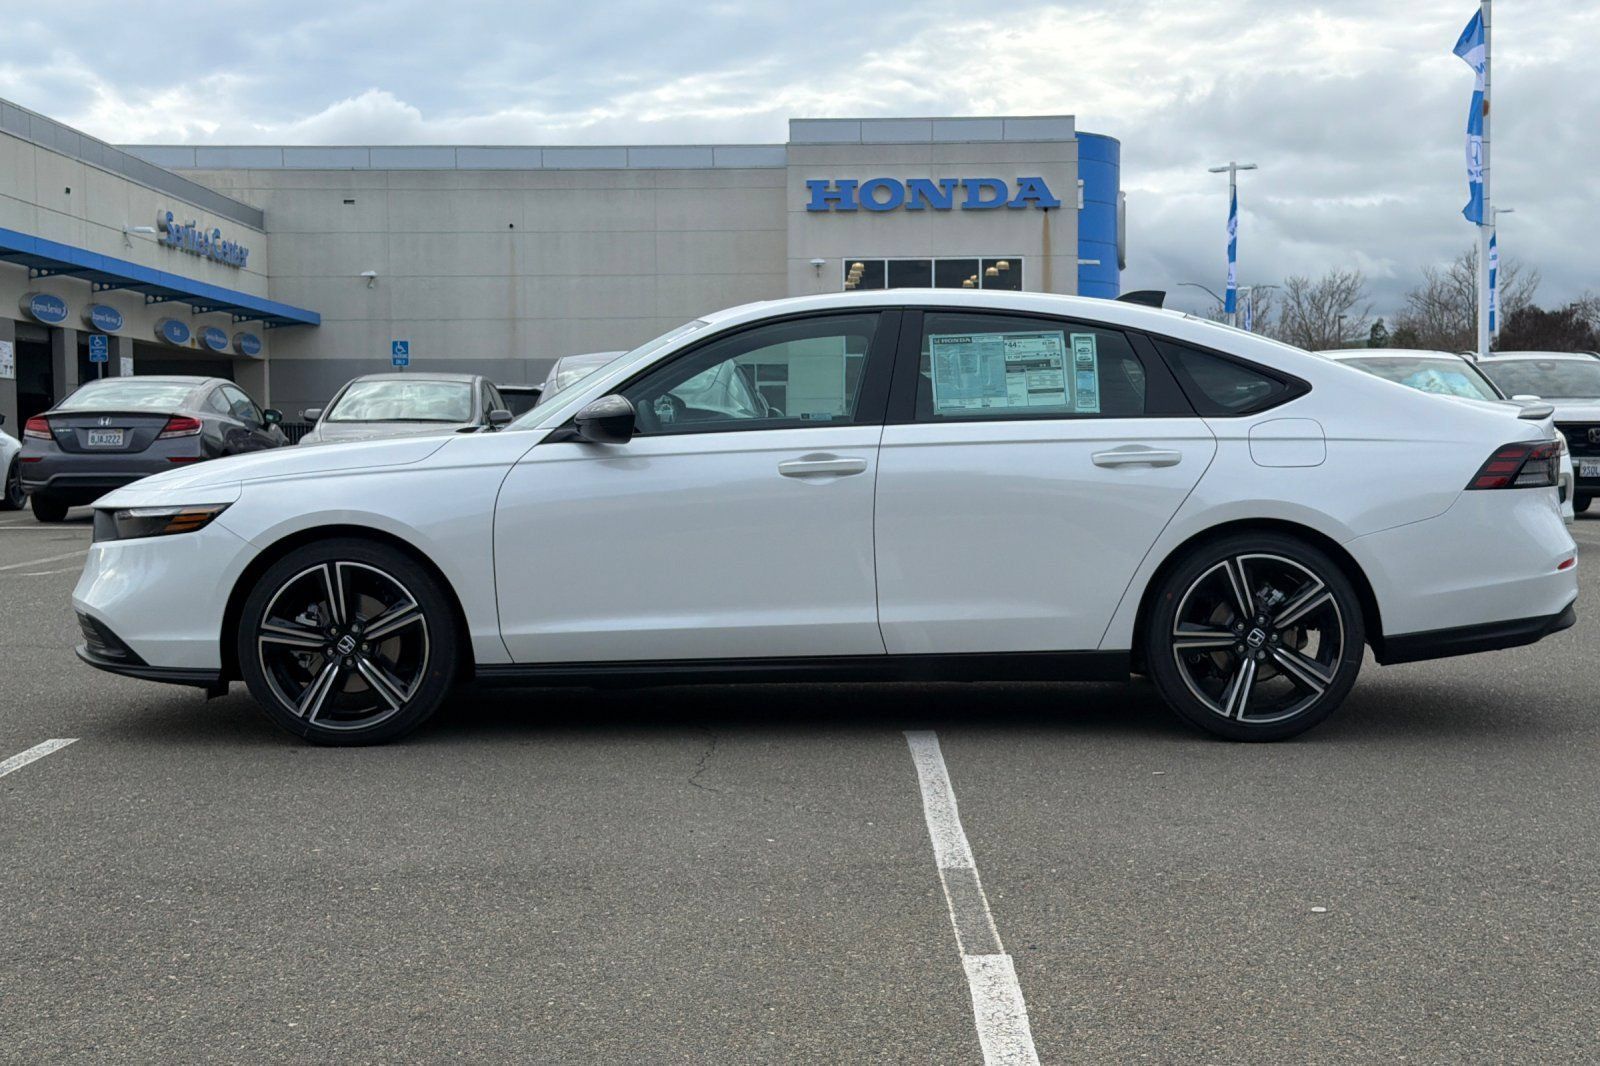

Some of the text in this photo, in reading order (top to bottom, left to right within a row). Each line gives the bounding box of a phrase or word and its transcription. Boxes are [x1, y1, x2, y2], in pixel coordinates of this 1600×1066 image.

[806, 177, 1061, 212] HONDA
[165, 211, 248, 268] Service Center
